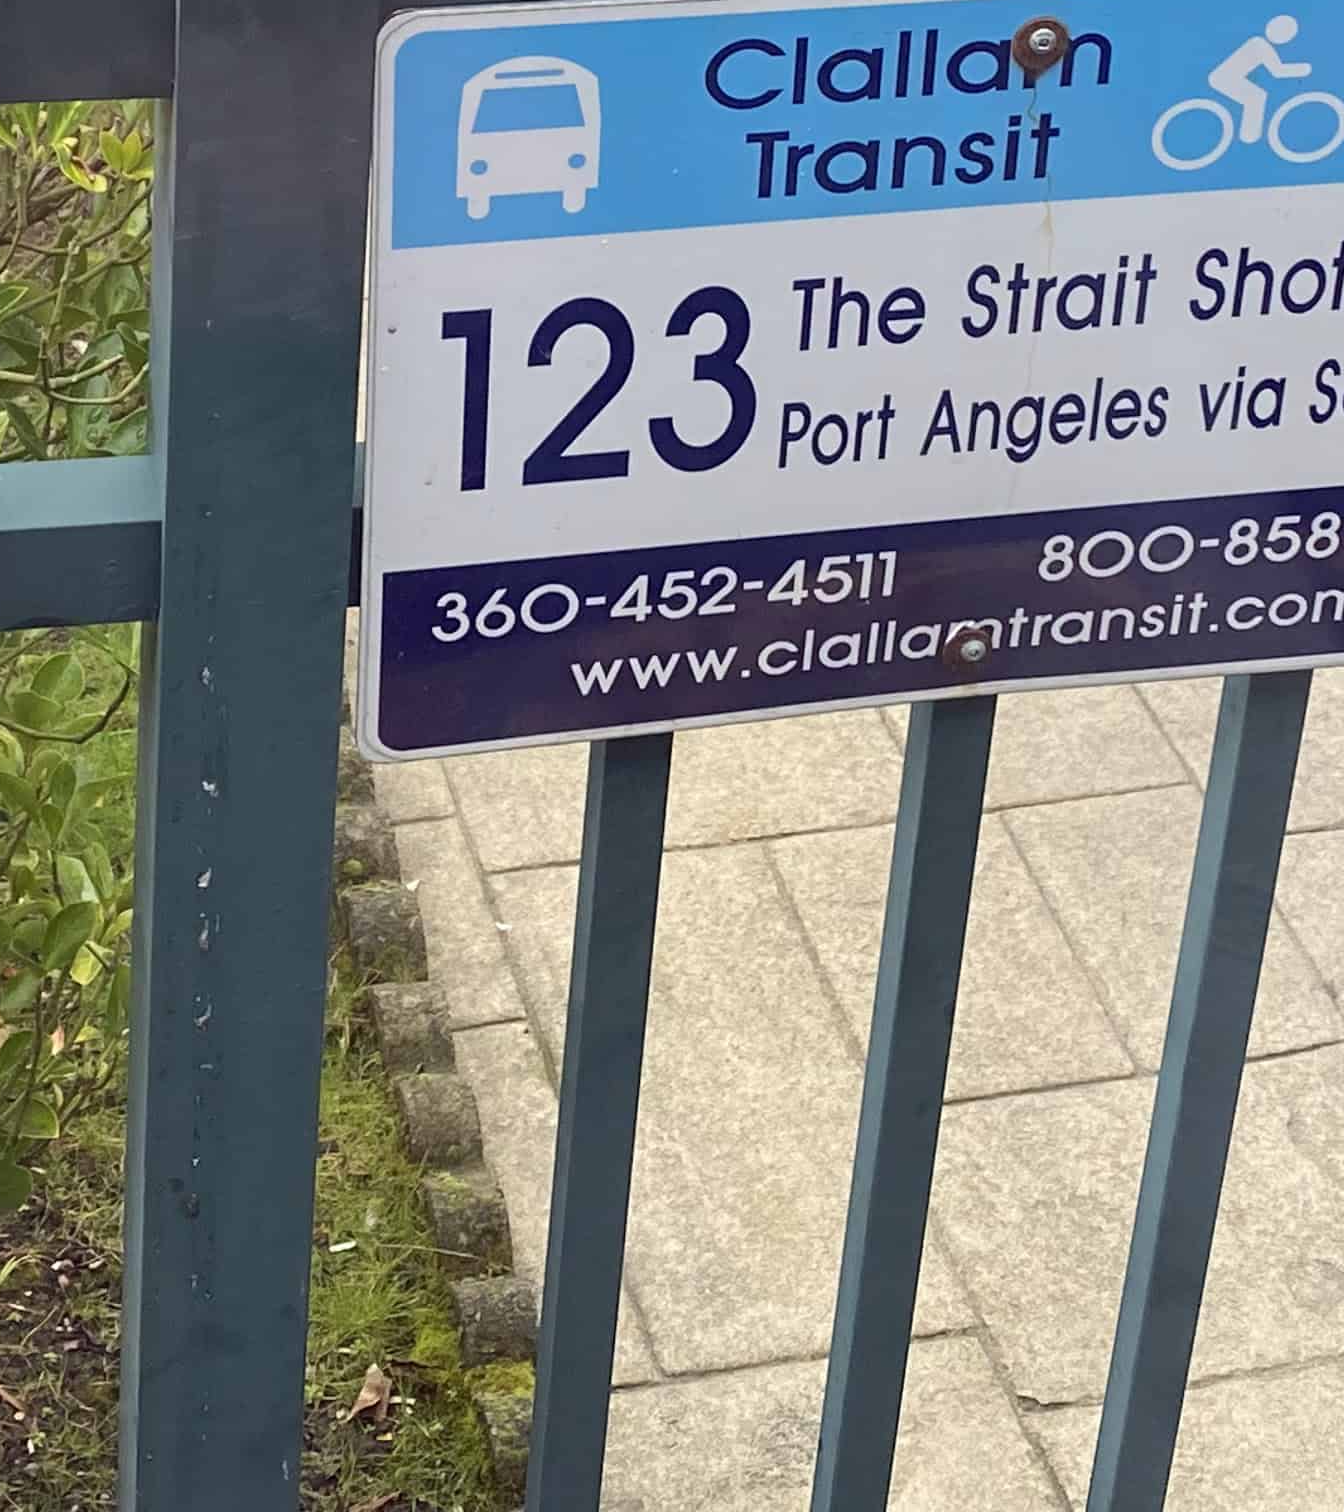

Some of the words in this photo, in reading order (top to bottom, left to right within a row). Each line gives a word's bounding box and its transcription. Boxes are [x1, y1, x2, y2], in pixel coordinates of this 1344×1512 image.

[746, 113, 1060, 198] Transit
[791, 270, 926, 352] The
[961, 254, 1156, 338] Strait
[438, 286, 756, 494] 123
[780, 395, 895, 471] Port
[920, 379, 1170, 464] Angeles
[1198, 368, 1285, 434] via
[430, 551, 899, 644] 360-452-4511
